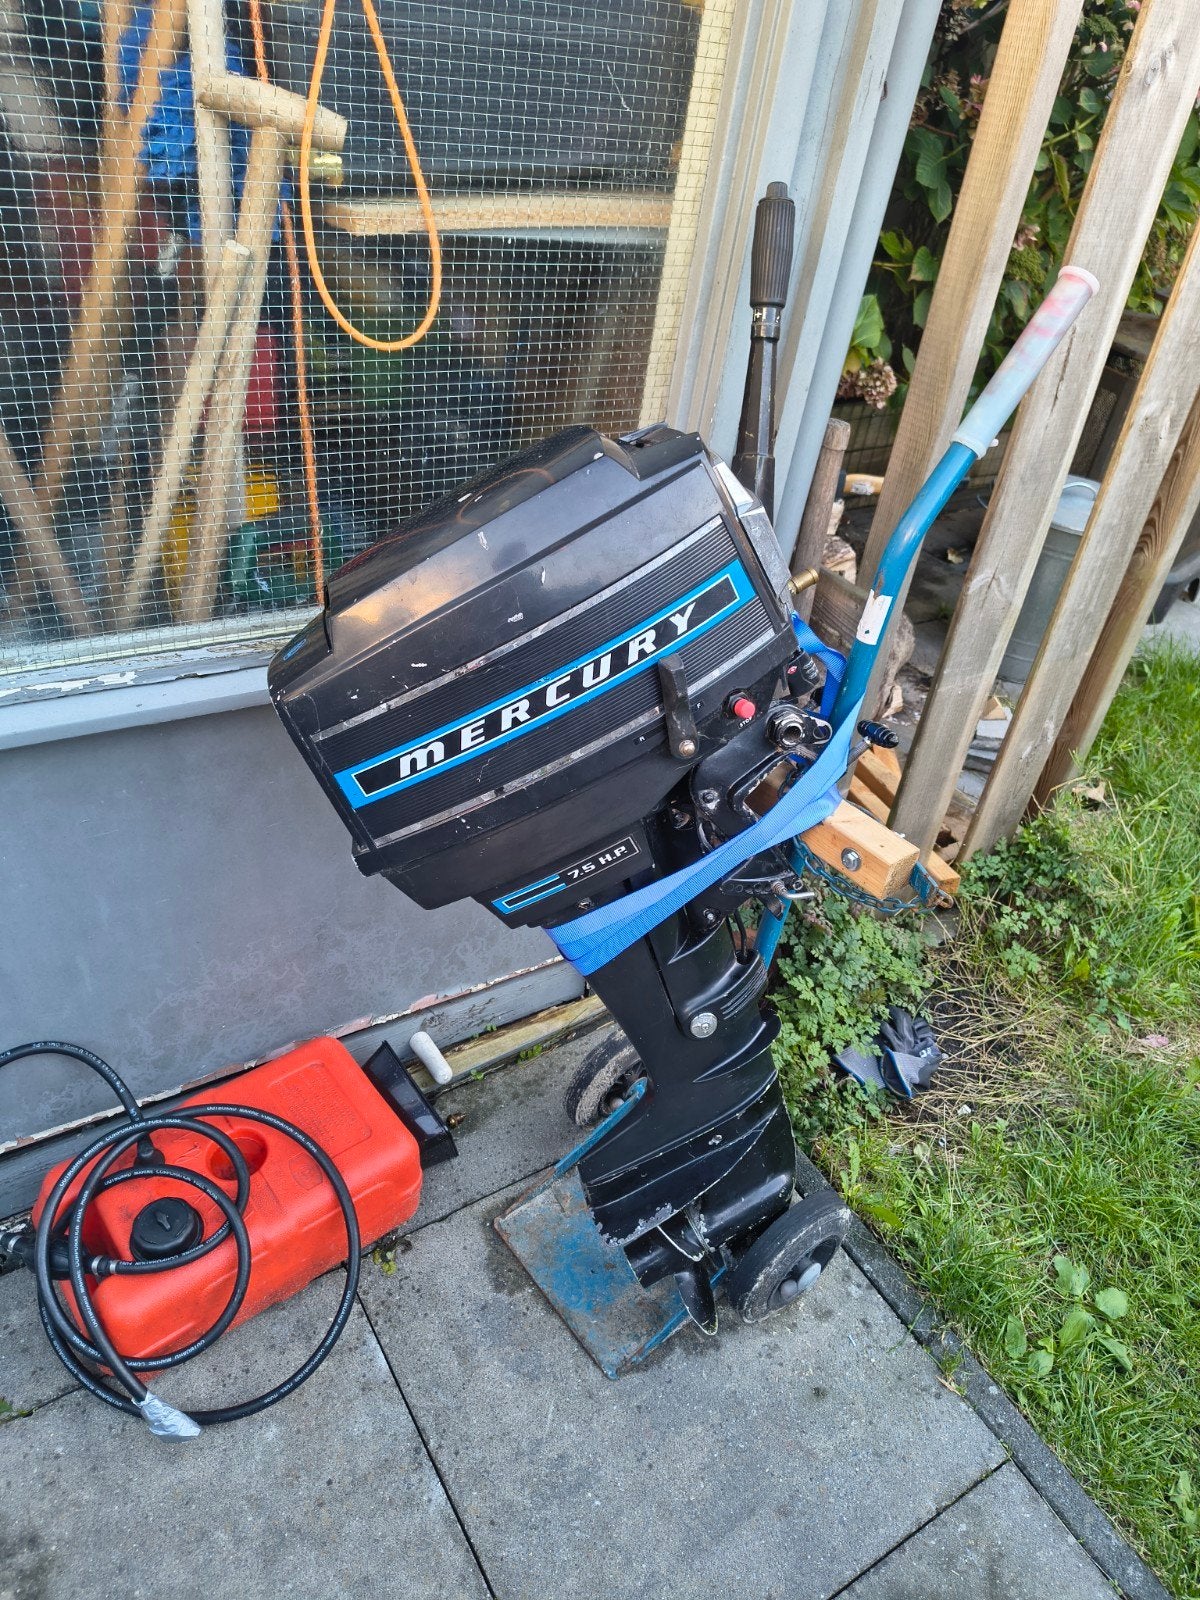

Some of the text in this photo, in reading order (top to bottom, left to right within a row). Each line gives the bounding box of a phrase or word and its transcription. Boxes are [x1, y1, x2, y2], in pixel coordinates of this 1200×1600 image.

[398, 602, 696, 779] MERCURY
[567, 846, 628, 879] 7.5 H.P.
